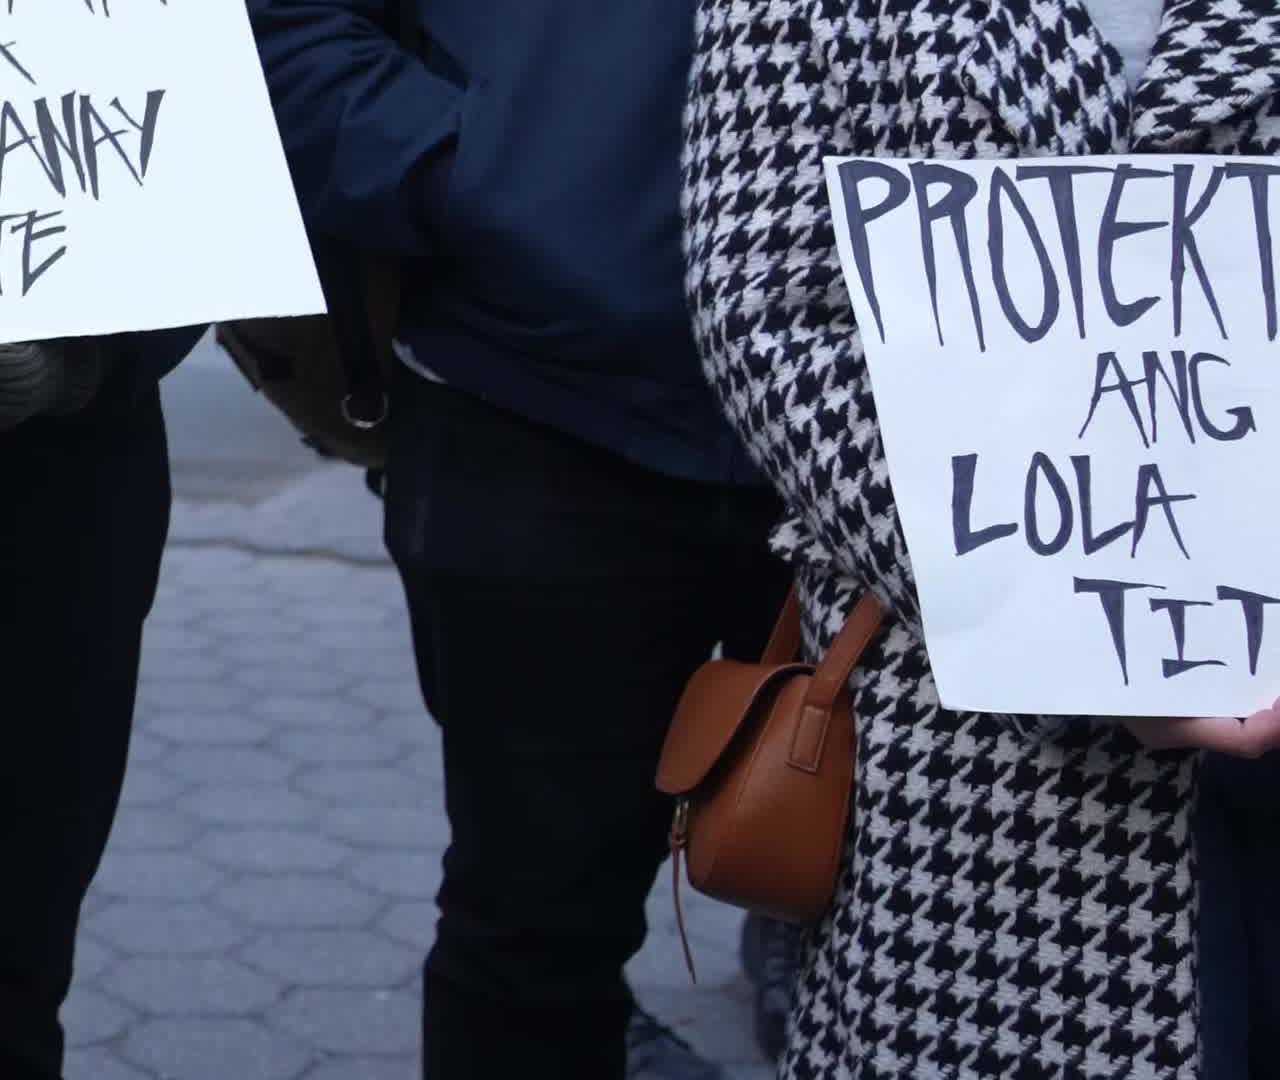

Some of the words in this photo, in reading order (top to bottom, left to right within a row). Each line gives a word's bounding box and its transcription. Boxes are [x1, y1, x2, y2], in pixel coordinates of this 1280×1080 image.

[836, 158, 1280, 353] PROTEKT
[1077, 350, 1257, 449] ANG
[951, 450, 1197, 561] LOLA
[1072, 575, 1280, 687] TIT
